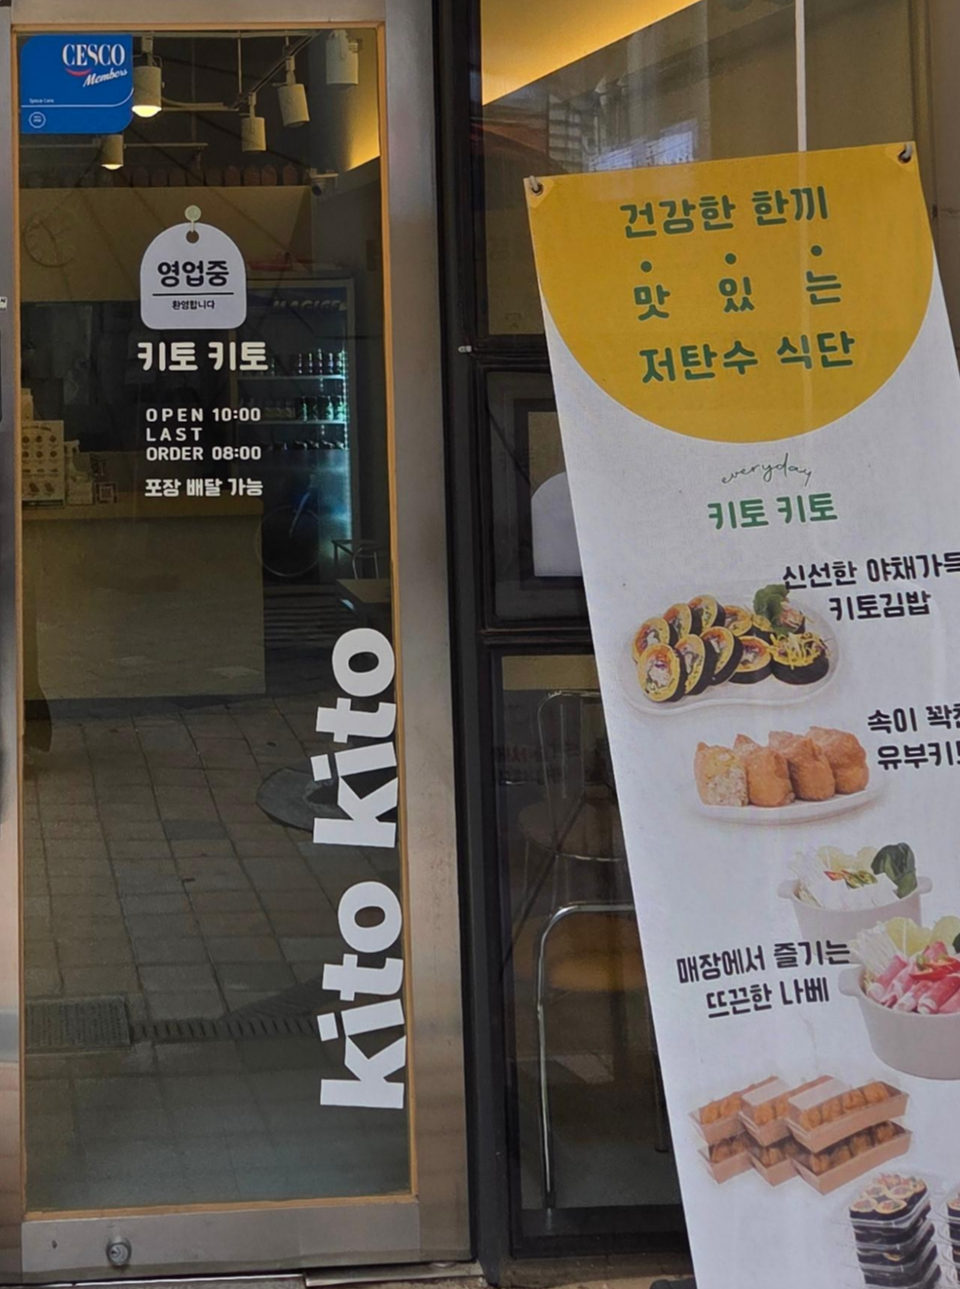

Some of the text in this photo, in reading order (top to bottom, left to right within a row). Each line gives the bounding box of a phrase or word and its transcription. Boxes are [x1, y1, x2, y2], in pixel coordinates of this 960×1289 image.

[62, 43, 126, 66] CESCO
[82, 67, 128, 87] Members
[620, 185, 828, 239] 건강한 한끼
[157, 260, 230, 288] 영업중
[172, 299, 215, 310] 환영합니다
[138, 341, 269, 371] 키토 키토
[639, 330, 855, 383] 저탄수 식단
[146, 408, 261, 422] OPEN 10:00
[146, 427, 203, 441] LAST
[146, 446, 261, 461] ORDER 08:00
[721, 452, 812, 487] everyday
[145, 478, 263, 497] 포장 배달 가능
[707, 492, 838, 530] 키토 키토
[783, 552, 960, 590] 신선한 야채가득
[829, 590, 931, 621] 키토김밥
[868, 707, 917, 734] 속이
[878, 740, 960, 770] 유부키
[311, 628, 406, 1109] kito kito
[676, 940, 851, 984] 매장에서 즐기는
[706, 977, 830, 1019] 뜨끈한 나베
